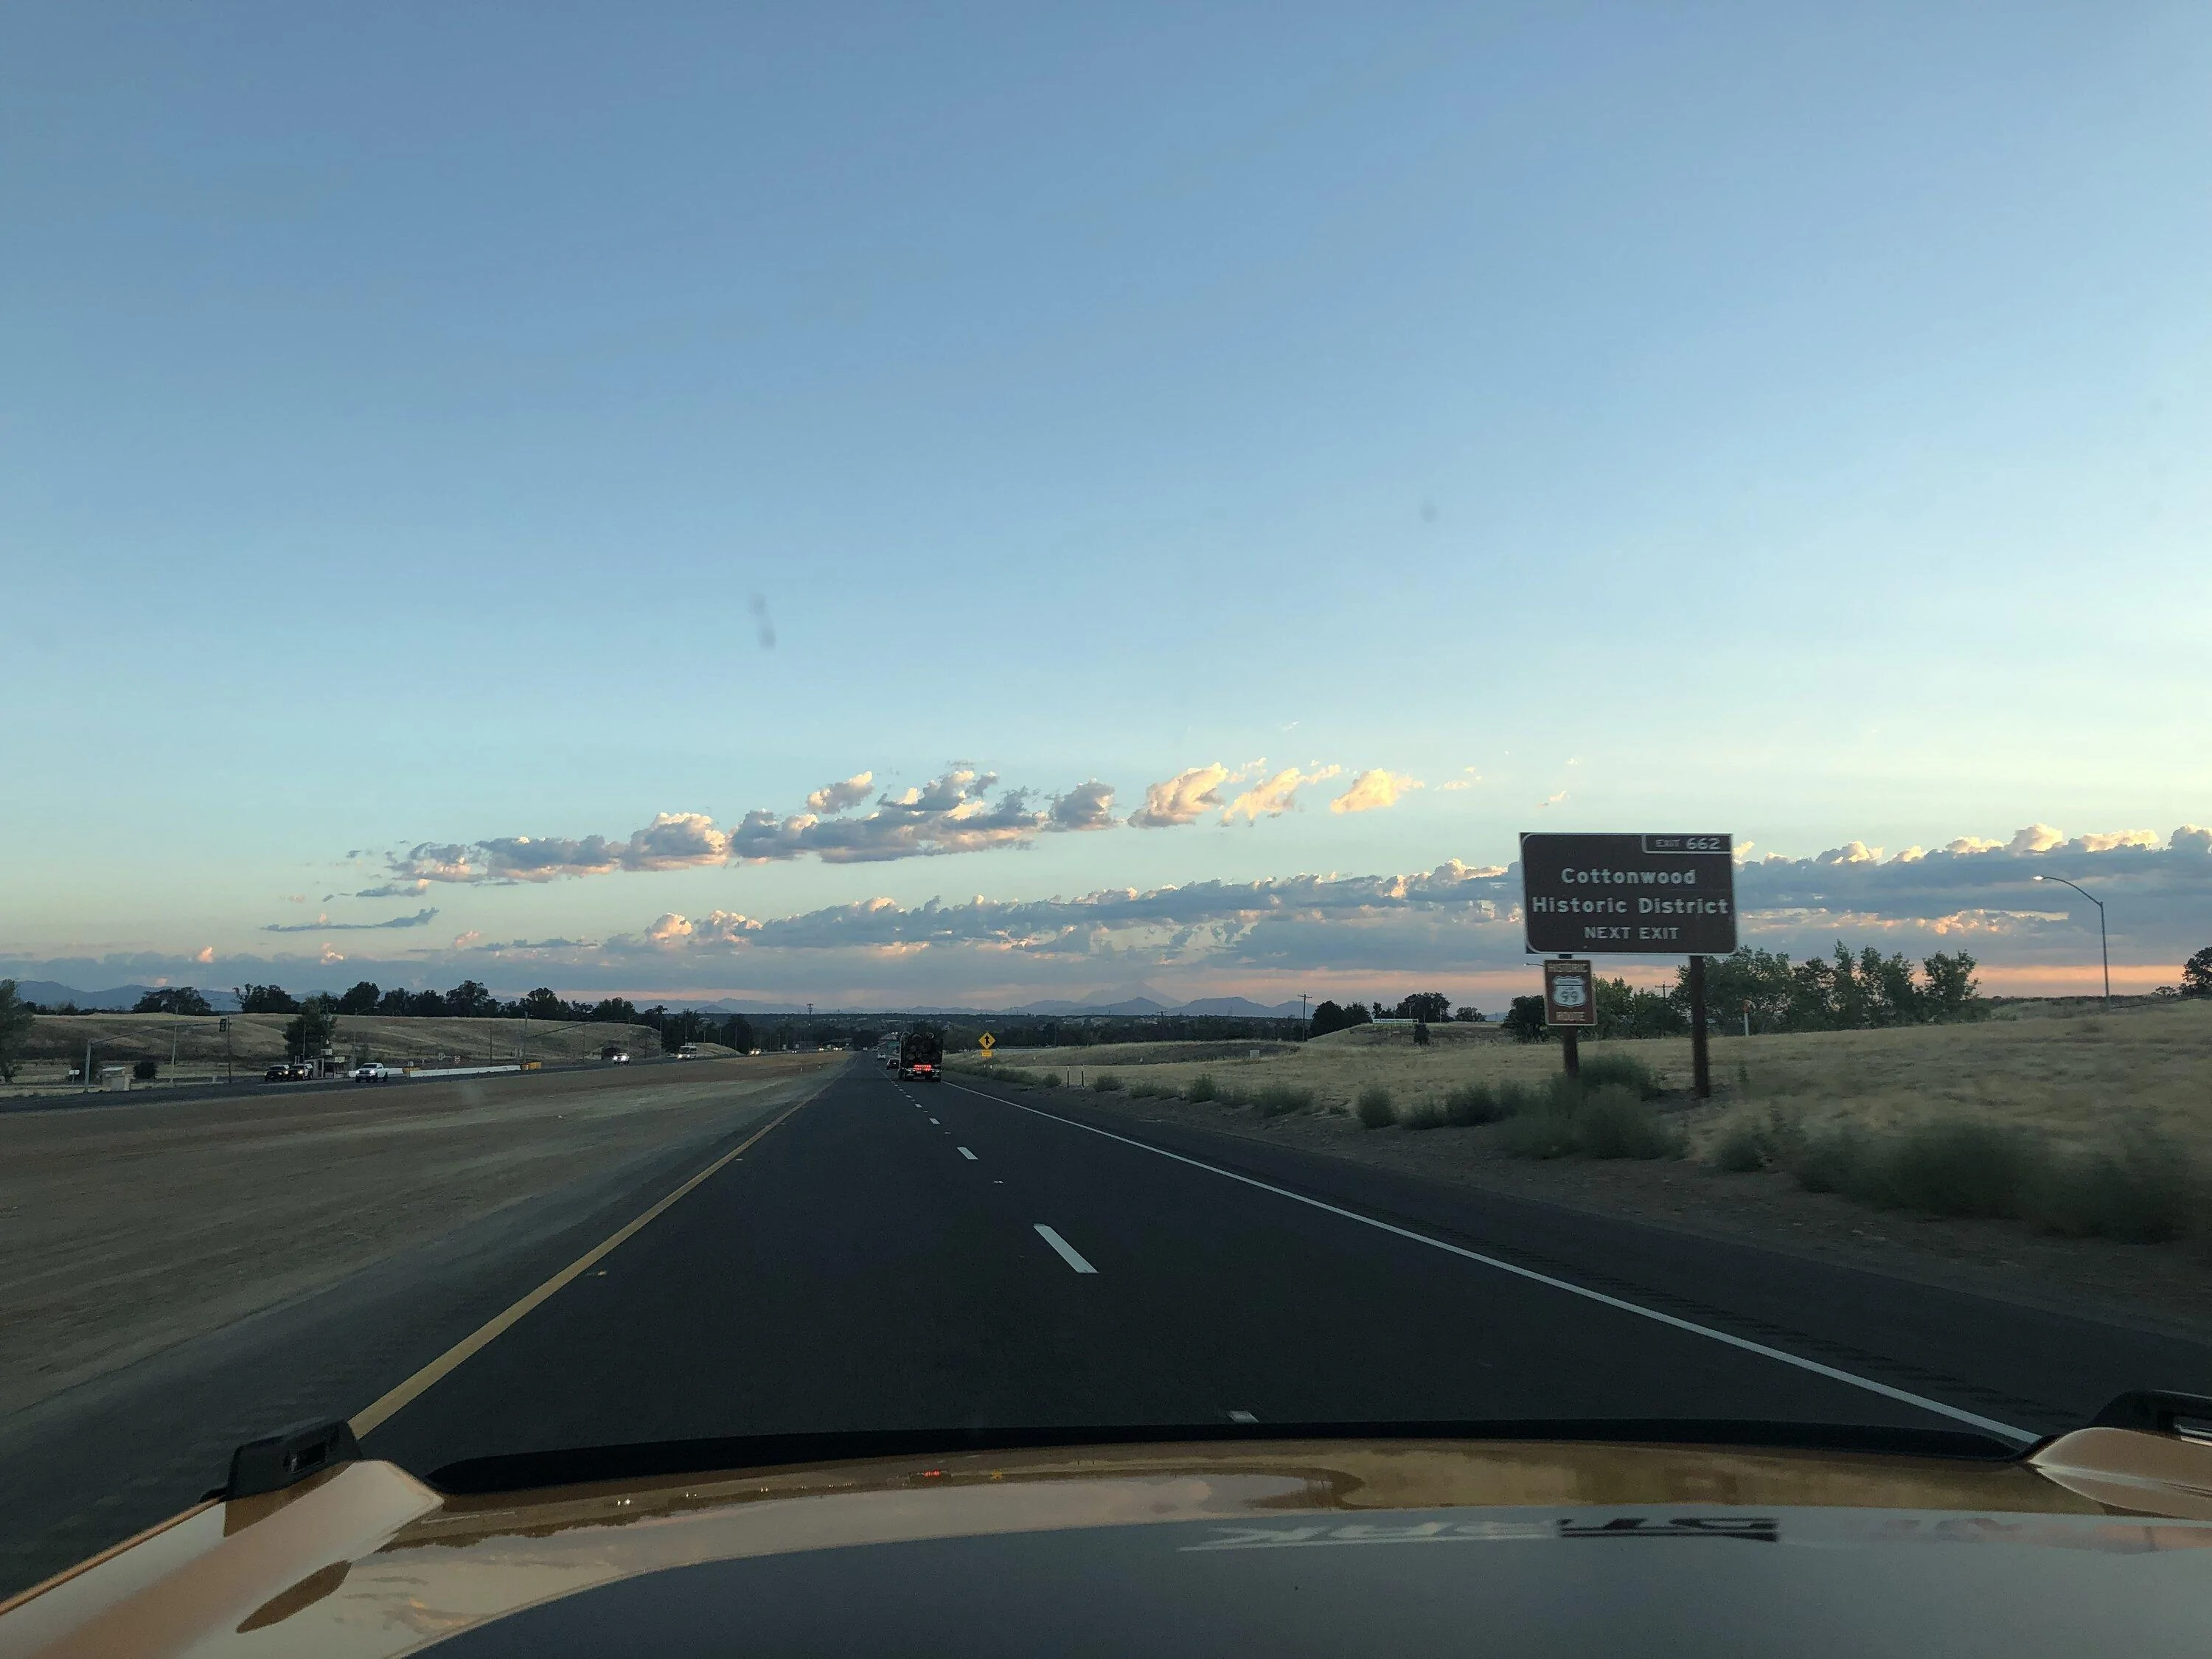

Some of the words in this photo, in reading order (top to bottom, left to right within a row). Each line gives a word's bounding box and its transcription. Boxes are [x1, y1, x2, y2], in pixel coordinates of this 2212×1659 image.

[1655, 839, 1680, 847] EXIT
[1686, 837, 1721, 849] 662
[1561, 868, 1696, 884] Cottonwood
[1532, 897, 1627, 914] Historic
[1638, 897, 1728, 914] District
[1585, 927, 1630, 939] NEXT
[1639, 927, 1679, 939] EXIT
